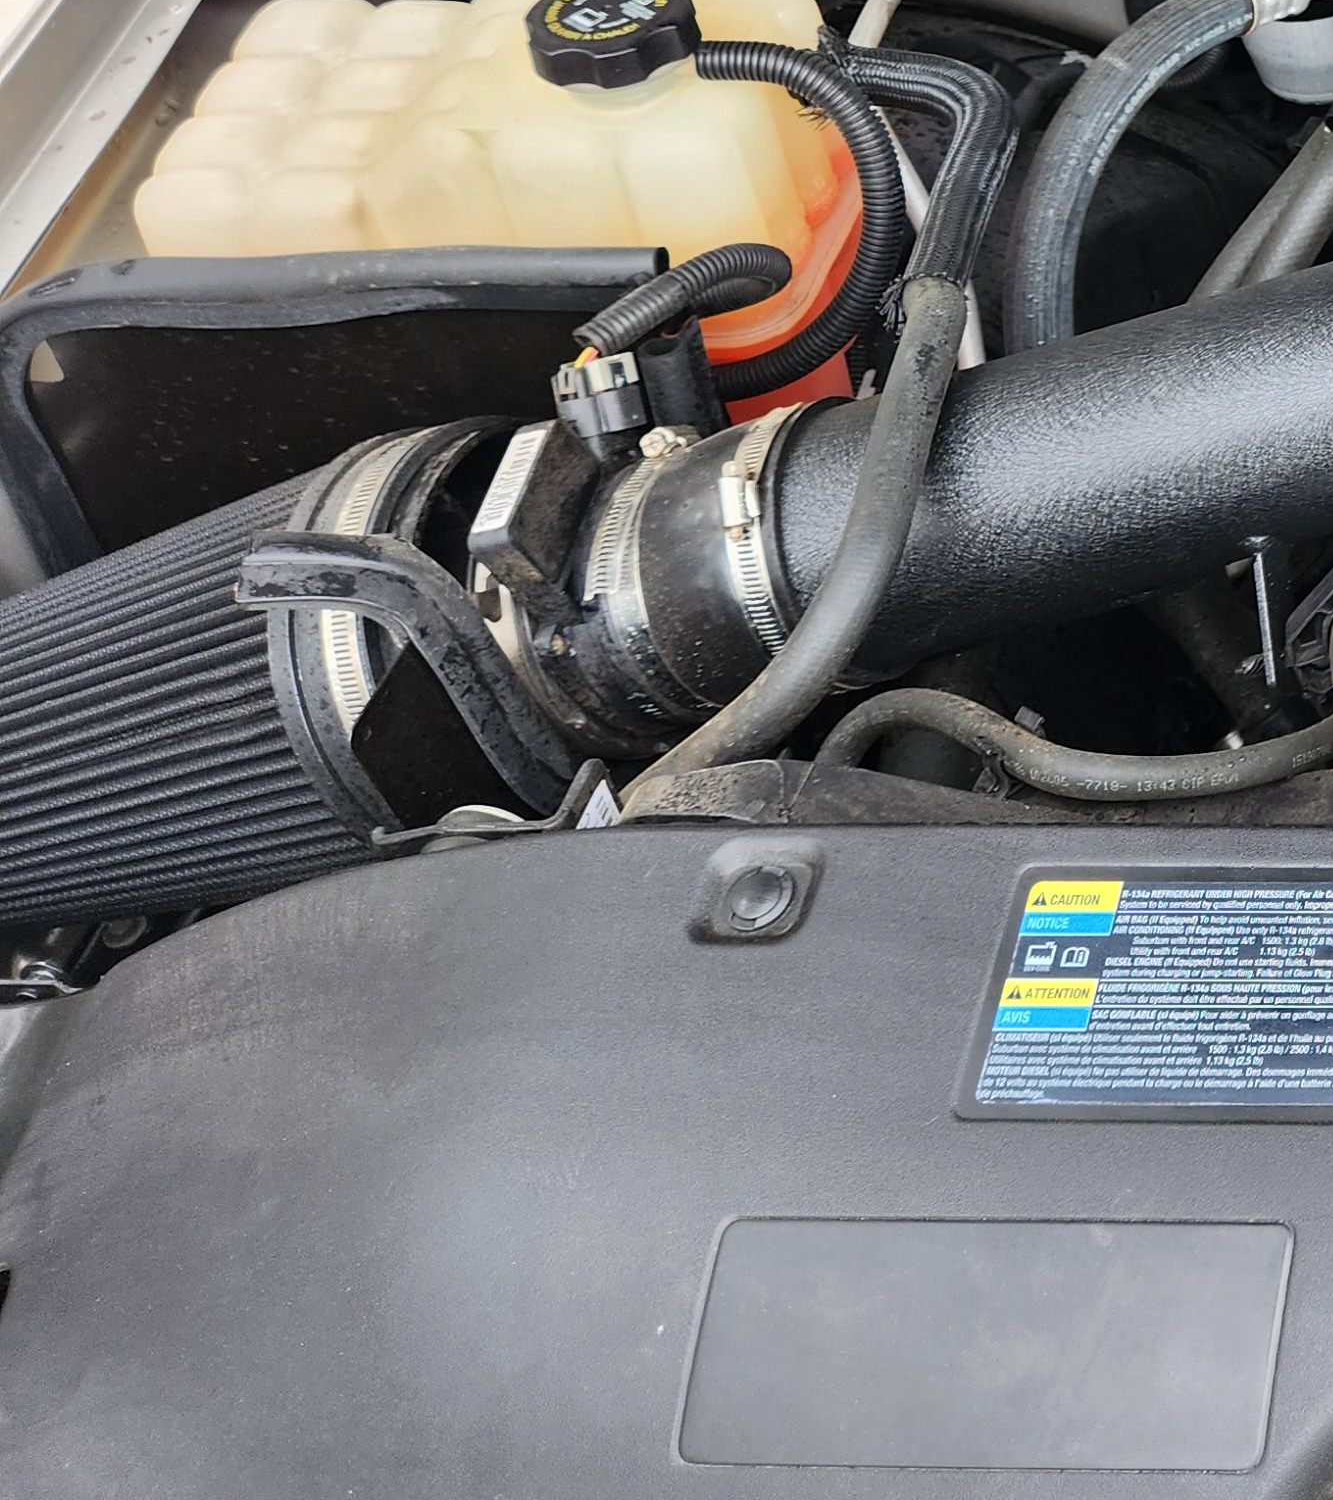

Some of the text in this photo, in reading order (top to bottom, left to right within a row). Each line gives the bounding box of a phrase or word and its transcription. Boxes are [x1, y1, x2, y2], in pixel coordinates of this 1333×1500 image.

[1136, 779, 1175, 792] 13:43
[1121, 889, 1150, 897] R-134a
[1150, 889, 1204, 897] REFRIGERANT
[1204, 889, 1232, 897] UNDER
[1233, 889, 1253, 897] HIGH
[1253, 889, 1295, 898] PRESSURE
[1295, 890, 1312, 899] (For
[1312, 890, 1324, 898] Air
[1050, 894, 1101, 906] CAUTION
[1119, 900, 1148, 909] System
[1168, 900, 1201, 908] serviced
[1212, 900, 1246, 909] qualified
[1246, 900, 1284, 909] personnel
[1284, 900, 1303, 909] only.
[1027, 917, 1070, 929] NOTICE
[1115, 915, 1130, 923] AIR
[1130, 915, 1148, 923] BAG
[1148, 915, 1158, 924] (If
[1158, 915, 1199, 924] Equipped)
[1209, 915, 1227, 924] help
[1228, 915, 1249, 923] avoid
[1250, 914, 1288, 923] unwanted
[1288, 914, 1321, 924] inflation,
[1132, 936, 1169, 944] Suburban
[1170, 936, 1187, 944] with
[1188, 936, 1207, 944] front
[1207, 936, 1223, 944] and
[1240, 935, 1256, 945] A/C
[1284, 935, 1297, 944] 1.3
[1097, 982, 1126, 991] FLUIDE
[1180, 982, 1210, 991] R-134a
[1210, 982, 1232, 991] SOUS
[1233, 982, 1260, 991] HAUTE
[1260, 982, 1301, 991] PRESSION
[1301, 982, 1323, 992] (pour
[1024, 988, 1090, 999] ATTENTION
[1001, 1010, 1031, 1023] AVIS
